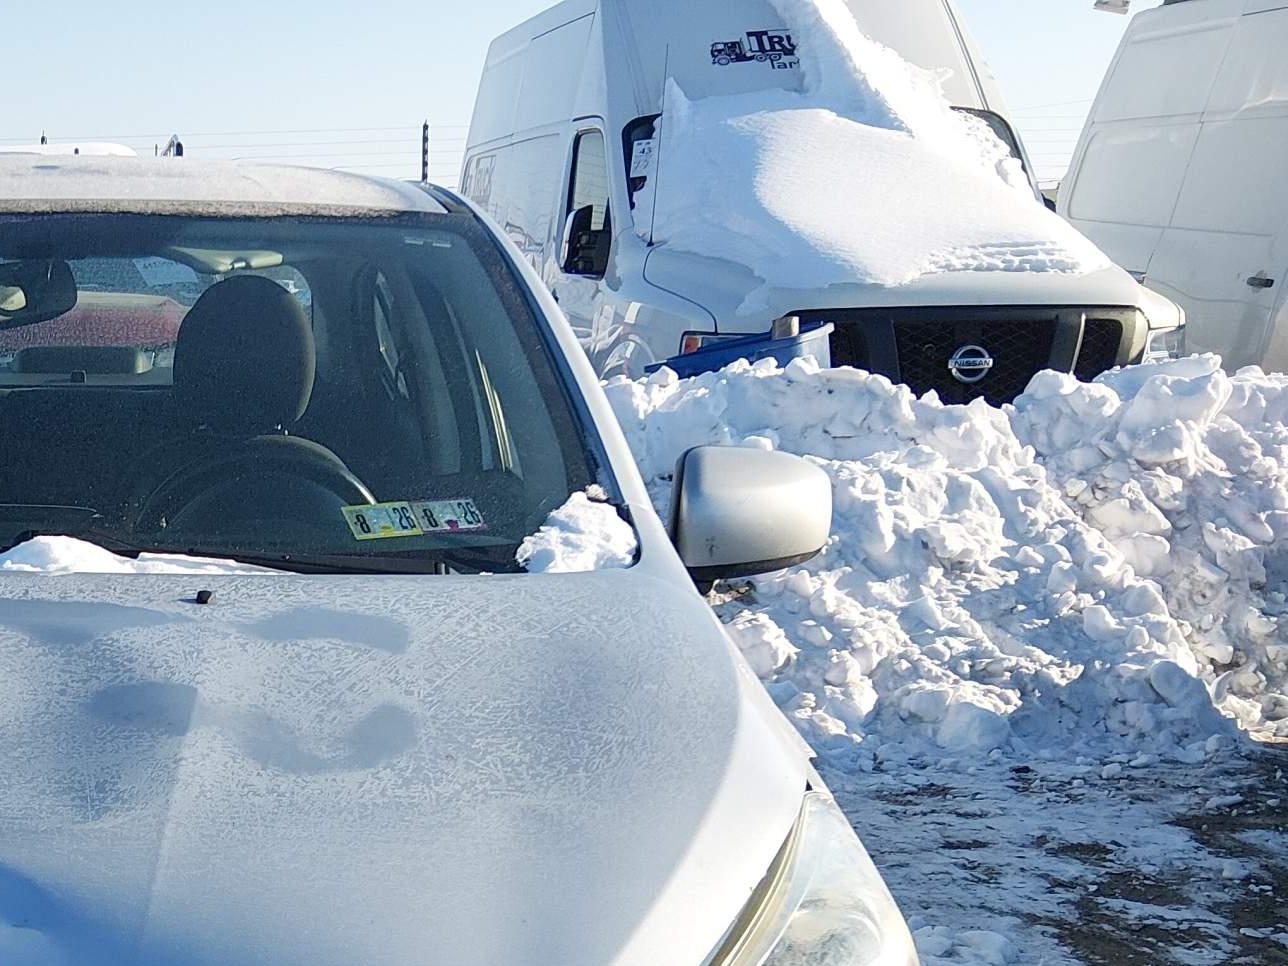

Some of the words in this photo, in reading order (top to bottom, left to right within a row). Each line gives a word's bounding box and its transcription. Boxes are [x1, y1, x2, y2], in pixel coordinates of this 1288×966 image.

[954, 360, 991, 368] NISSAN
[392, 506, 416, 530] 26
[457, 502, 481, 525] 26
